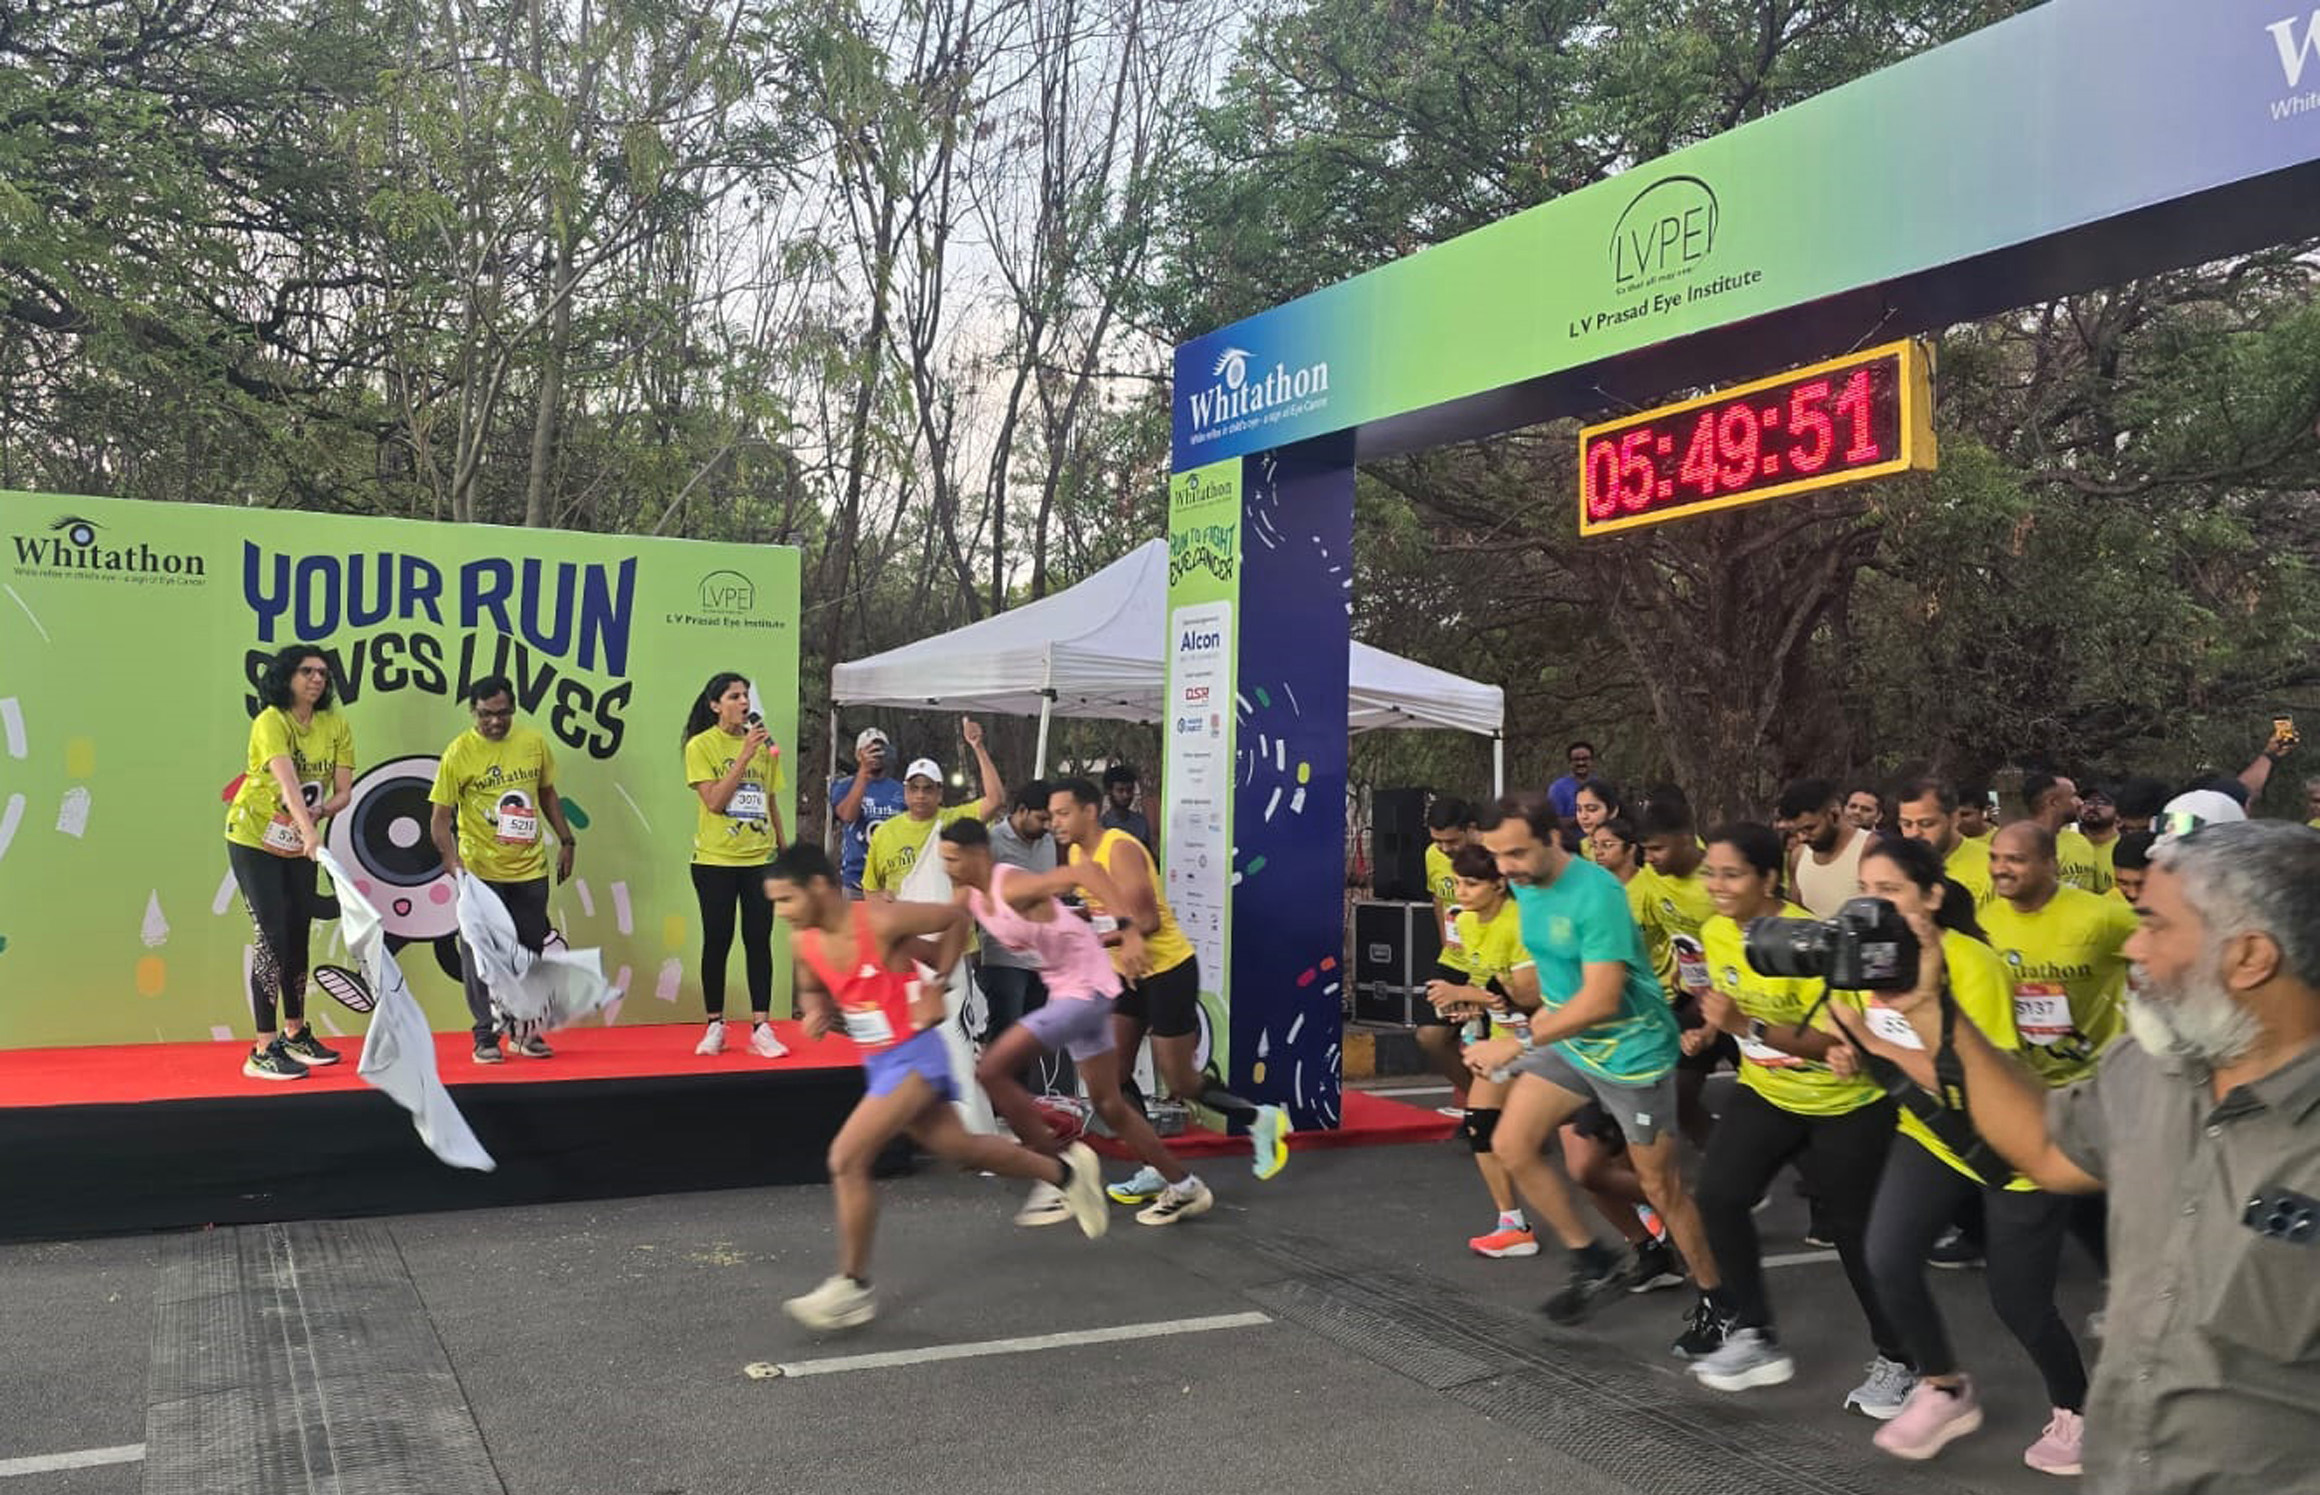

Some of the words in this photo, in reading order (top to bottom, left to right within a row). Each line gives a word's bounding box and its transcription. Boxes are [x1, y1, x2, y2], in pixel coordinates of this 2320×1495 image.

[2271, 91, 2320, 120] Whit
[1569, 323, 1579, 338] L
[1581, 317, 1592, 334] V
[1597, 299, 1649, 330] Prasad
[1653, 294, 1682, 314] Eye
[1688, 269, 1763, 302] Institute
[1189, 361, 1330, 431] Whitathon
[1586, 369, 1879, 519] 05:49:51
[12, 535, 206, 576] Whitathon
[1203, 522, 1235, 556] FIGHT
[243, 539, 443, 643] YOUR
[460, 556, 637, 677] RUN
[1180, 631, 1220, 651] Alcon
[245, 632, 448, 719] SVES
